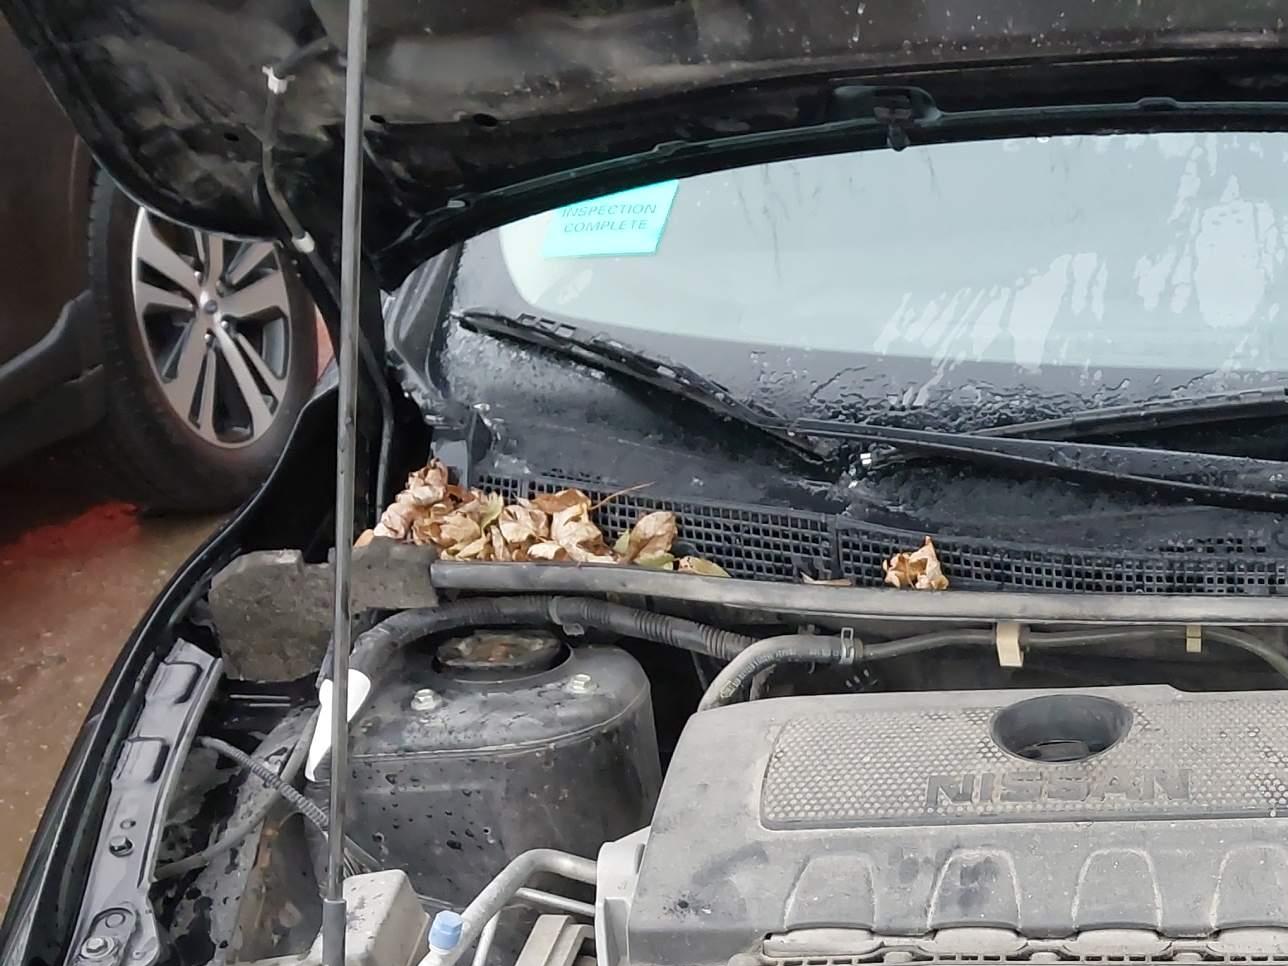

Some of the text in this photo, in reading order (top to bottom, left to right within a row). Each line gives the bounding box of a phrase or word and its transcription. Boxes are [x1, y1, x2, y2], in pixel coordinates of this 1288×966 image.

[562, 204, 657, 217] INSPECTION
[564, 219, 648, 232] COMPLETE
[926, 767, 1191, 808] NISSAN
